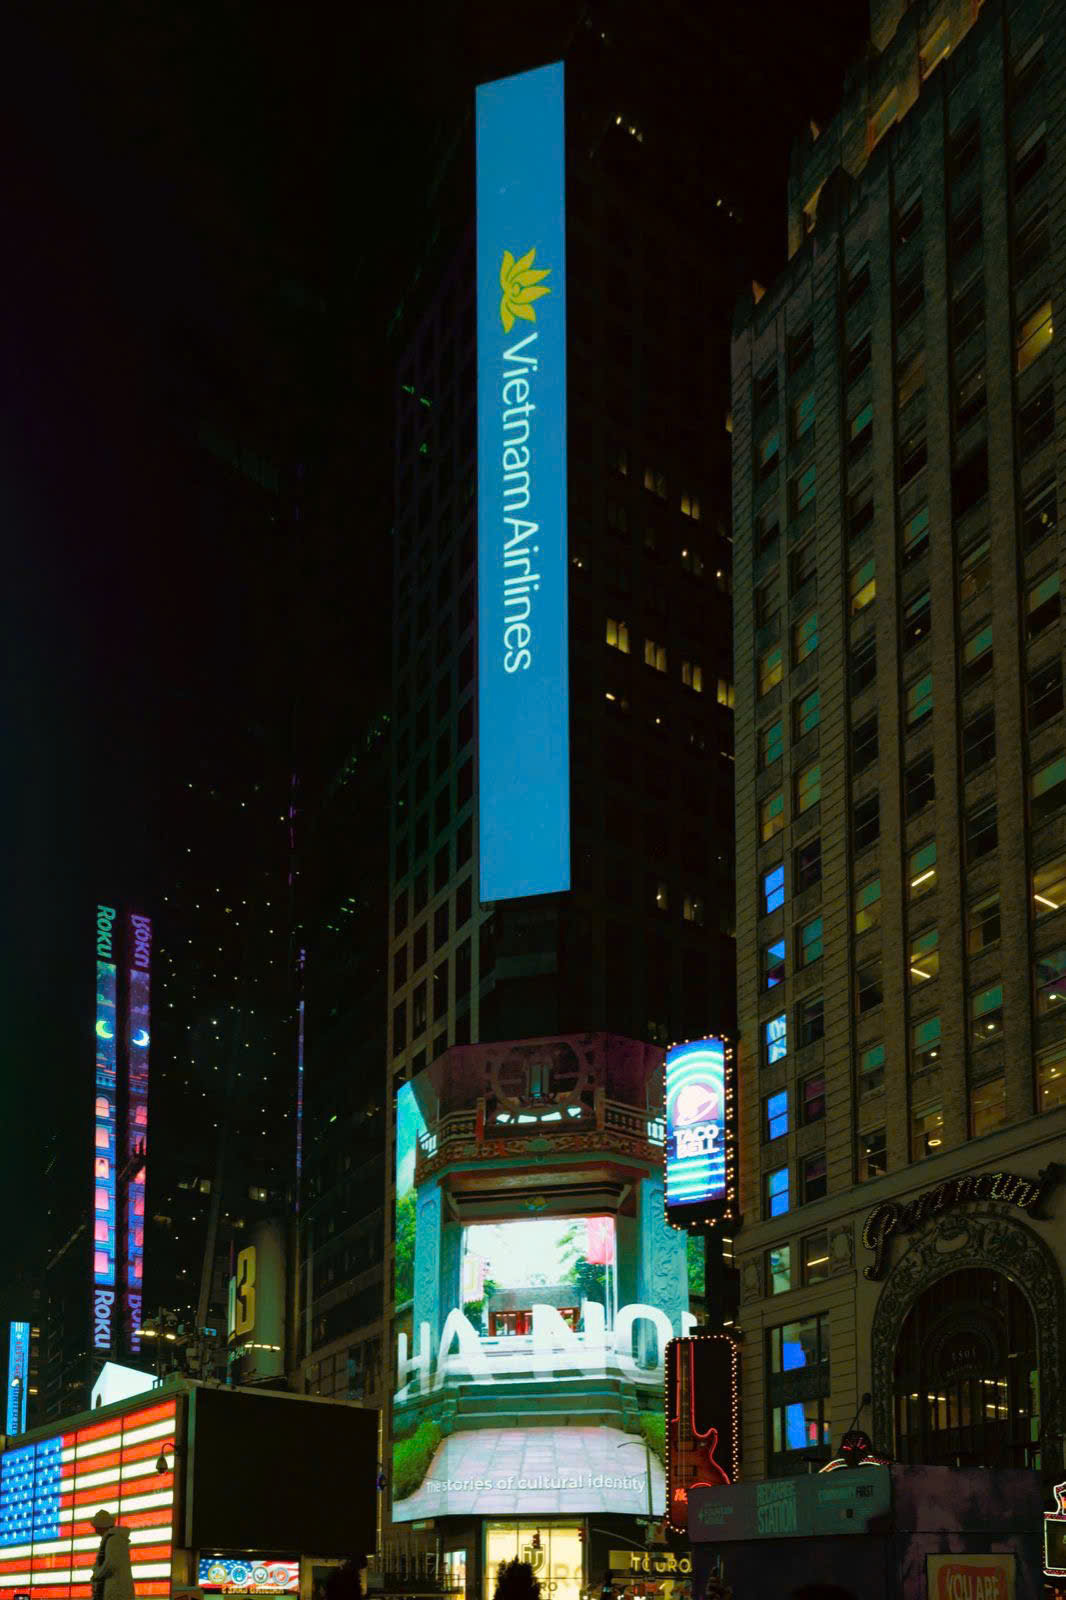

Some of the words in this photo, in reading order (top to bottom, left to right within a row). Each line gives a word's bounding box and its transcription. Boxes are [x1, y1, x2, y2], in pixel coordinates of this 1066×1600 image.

[502, 331, 539, 512] Vietnam
[503, 516, 541, 674] Airlines
[672, 1123, 720, 1144] TACO
[676, 1138, 721, 1159] BELL
[441, 1477, 492, 1492] stories
[496, 1475, 515, 1490] of
[517, 1473, 583, 1490] cultural
[588, 1473, 646, 1492] identity
